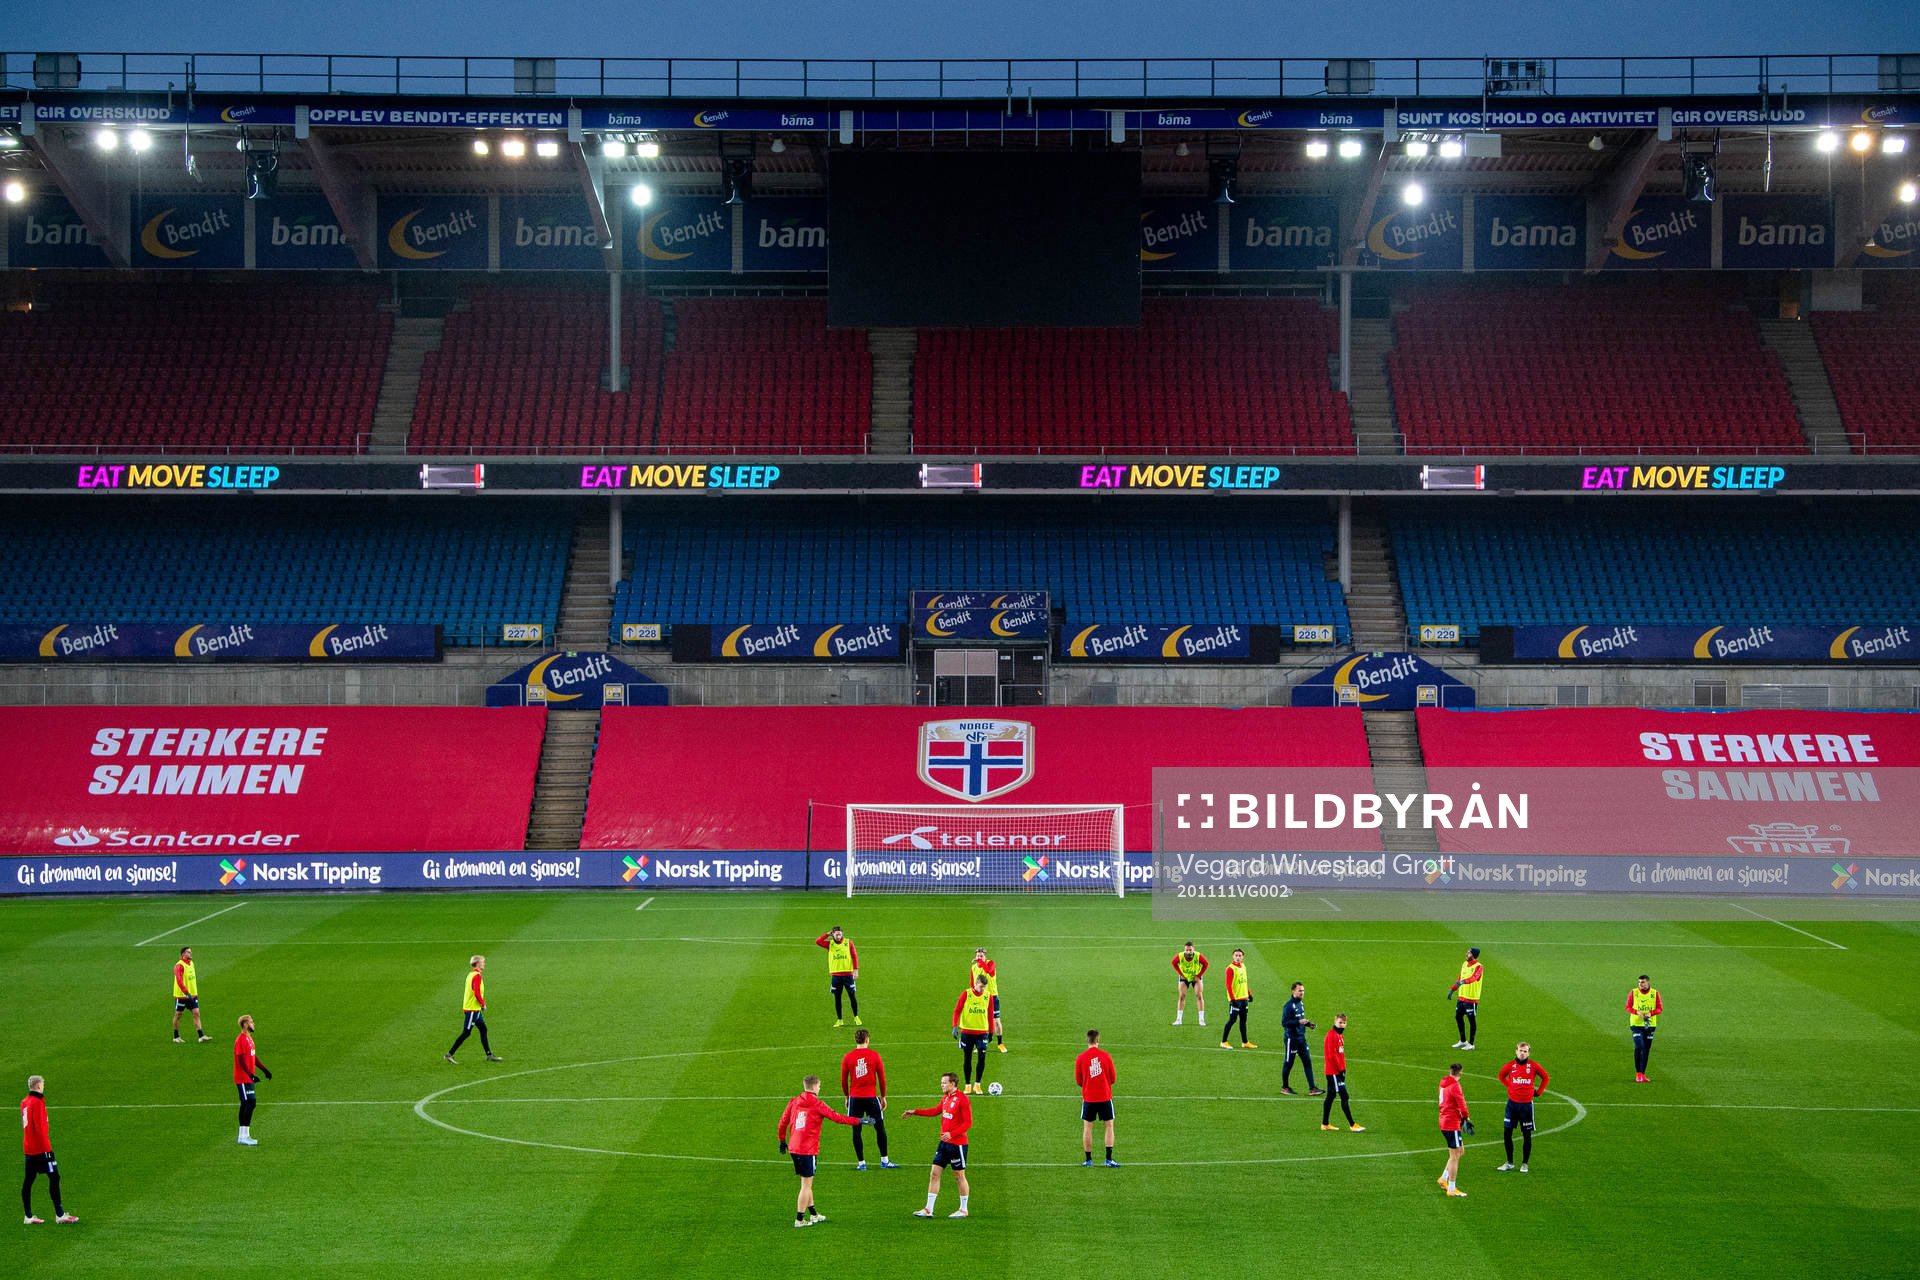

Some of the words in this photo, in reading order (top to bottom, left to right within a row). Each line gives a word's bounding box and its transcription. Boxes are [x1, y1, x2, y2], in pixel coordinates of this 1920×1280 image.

[36, 106, 66, 118] GIR
[70, 106, 170, 120] OVERSKUDD
[230, 106, 256, 118] Bendit
[310, 110, 385, 122] OPPLEV
[390, 111, 562, 124] BENDIT-EFFEKTEN
[608, 112, 642, 125] bama
[703, 110, 729, 124] Bendit
[781, 114, 814, 126] bama
[1158, 114, 1192, 126] bama
[1247, 110, 1273, 123] Bendit
[1320, 113, 1353, 124] bama
[1398, 112, 1444, 124] SUNT
[1448, 112, 1538, 124] KOSTHOLD
[1542, 112, 1566, 124] OG
[1570, 111, 1655, 124] AKTIVITET
[1672, 110, 1700, 122] GIR
[1870, 106, 1898, 119] Bendit
[25, 216, 98, 245] bam
[165, 209, 230, 245] Bendit
[412, 209, 476, 246] Bendit
[515, 218, 600, 246] bama
[660, 210, 724, 246] Bendit
[758, 218, 828, 248] bam
[1143, 210, 1208, 247] Bendit
[1246, 218, 1332, 248] bama
[1392, 209, 1456, 246] Bendit
[1491, 217, 1576, 246] bama
[1632, 209, 1697, 246] Bendit
[1738, 216, 1825, 246] bama
[1880, 222, 1920, 244] Ben
[78, 466, 124, 488] EAT
[128, 465, 206, 488] MOVE
[207, 466, 280, 489] SLEEP
[581, 466, 627, 488] EAT
[630, 465, 706, 488] MOVE
[709, 466, 780, 489] SLEEP
[1080, 466, 1126, 488] EAT
[1130, 465, 1206, 488] MOVE
[1208, 466, 1280, 489] SLEEP
[1583, 466, 1629, 488] EAT
[1632, 465, 1710, 488] MOVE
[1712, 466, 1785, 489] SLEEP
[938, 610, 972, 629] Bendit
[1002, 610, 1036, 629] Bendit
[60, 624, 119, 656] Bendit
[196, 624, 254, 656] Bendit
[331, 624, 388, 656] Bendit
[507, 630, 526, 638] 227
[638, 630, 656, 638] 228
[742, 624, 800, 656] Bendit
[835, 624, 892, 656] Bendit
[1091, 624, 1148, 656] Bendit
[1184, 624, 1240, 656] Bendit
[1298, 631, 1316, 640] 228
[1437, 631, 1454, 639] 229
[1580, 625, 1638, 658] Bendit
[1715, 625, 1774, 658] Bendit
[1852, 625, 1910, 658] Bendit
[550, 654, 612, 688] Bendit
[1356, 654, 1418, 689] Bendit
[960, 722, 994, 730] NORGE
[90, 728, 328, 757] STERKERE
[1639, 732, 1880, 763] STERKERE
[88, 764, 304, 796] SAMMEN
[1661, 769, 1882, 802] SAMMEN
[106, 830, 300, 847] Santander
[939, 832, 1066, 846] telenor
[1744, 840, 1836, 854] TINE
[18, 865, 35, 886] Gi
[39, 862, 102, 884] drømmen
[104, 864, 122, 882] en
[126, 861, 178, 886] sjanse!
[253, 862, 308, 881] Norsk
[310, 862, 382, 884] Tipping
[422, 859, 440, 880] Gi
[444, 858, 506, 880] drømmen
[509, 860, 527, 876] en
[530, 857, 580, 881] sjanse!
[656, 860, 711, 878] Norsk
[713, 860, 782, 882] Tipping
[824, 858, 841, 879] Gi
[910, 860, 927, 876] en
[930, 857, 980, 880] sjanse!
[1056, 860, 1111, 879] Norsk
[1114, 861, 1183, 882] Tipping
[1458, 862, 1514, 882] Norsk
[1516, 864, 1588, 886] Tipping
[1628, 863, 1646, 884] Gi
[1651, 863, 1712, 884] drømmen
[1716, 866, 1734, 882] en
[1738, 864, 1790, 888] sjanse!
[1866, 868, 1920, 886] Norsk
